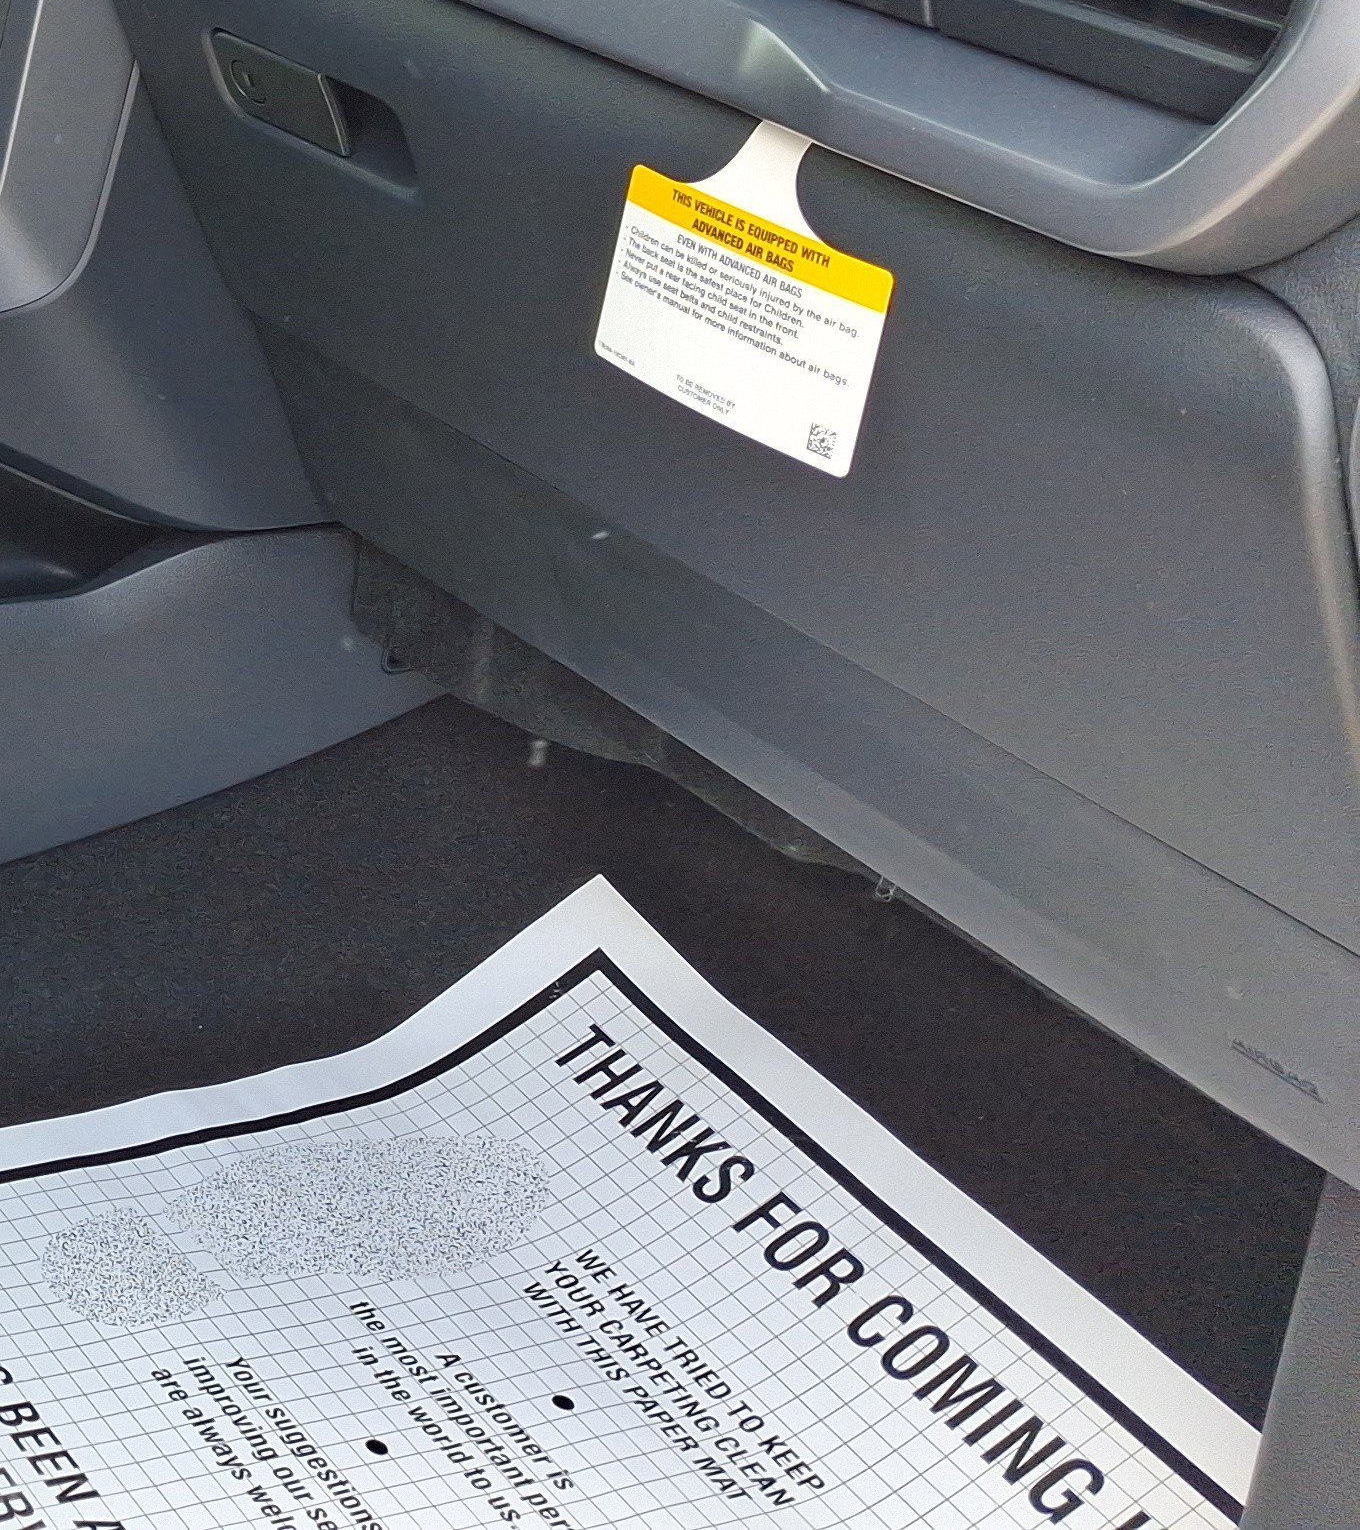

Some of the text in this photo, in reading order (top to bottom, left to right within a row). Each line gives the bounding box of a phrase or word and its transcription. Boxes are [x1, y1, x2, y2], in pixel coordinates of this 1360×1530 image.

[626, 248, 645, 265] Never
[682, 277, 706, 298] facing
[708, 290, 727, 306] child
[730, 301, 747, 316] seat
[749, 309, 757, 320] in
[759, 314, 773, 327] the
[628, 236, 641, 249] The
[686, 266, 698, 279] the
[700, 273, 723, 291] safest
[725, 285, 747, 304] place
[750, 297, 762, 309] for
[672, 189, 830, 268] THIS VEHICLE IS EQUIPPED WITH
[677, 233, 802, 299] EVEN WITH ADVANCED AIR BAGS
[692, 217, 794, 273] ADVANCED AIR BAGS
[663, 295, 690, 314] manual
[692, 309, 703, 320] for
[705, 316, 725, 331] more
[728, 326, 777, 356] information
[779, 350, 806, 369] about
[809, 363, 820, 374] air
[701, 300, 716, 314] and
[718, 308, 738, 324] child
[709, 265, 717, 275] or
[719, 270, 757, 296] seriously
[759, 287, 791, 311] injured
[792, 302, 804, 316] by
[807, 308, 821, 322] the
[824, 315, 836, 328] air
[555, 1023, 1105, 1525] THANKS FOR COMING
[151, 1368, 188, 1402] are
[182, 1407, 252, 1480] always
[183, 1356, 279, 1461] improving
[273, 1466, 315, 1501] our
[349, 1300, 576, 1530] the most important per
[434, 1353, 575, 1491] A customer is
[523, 1282, 753, 1501] WITH THIS PAPER MAT
[545, 1260, 796, 1507] YOUR CARPETING CLEAN
[575, 1248, 826, 1490] WE HAVE TRIED TO KEEP
[226, 1356, 383, 1530] Your suggestions
[352, 1346, 521, 1530] in the world to us.
